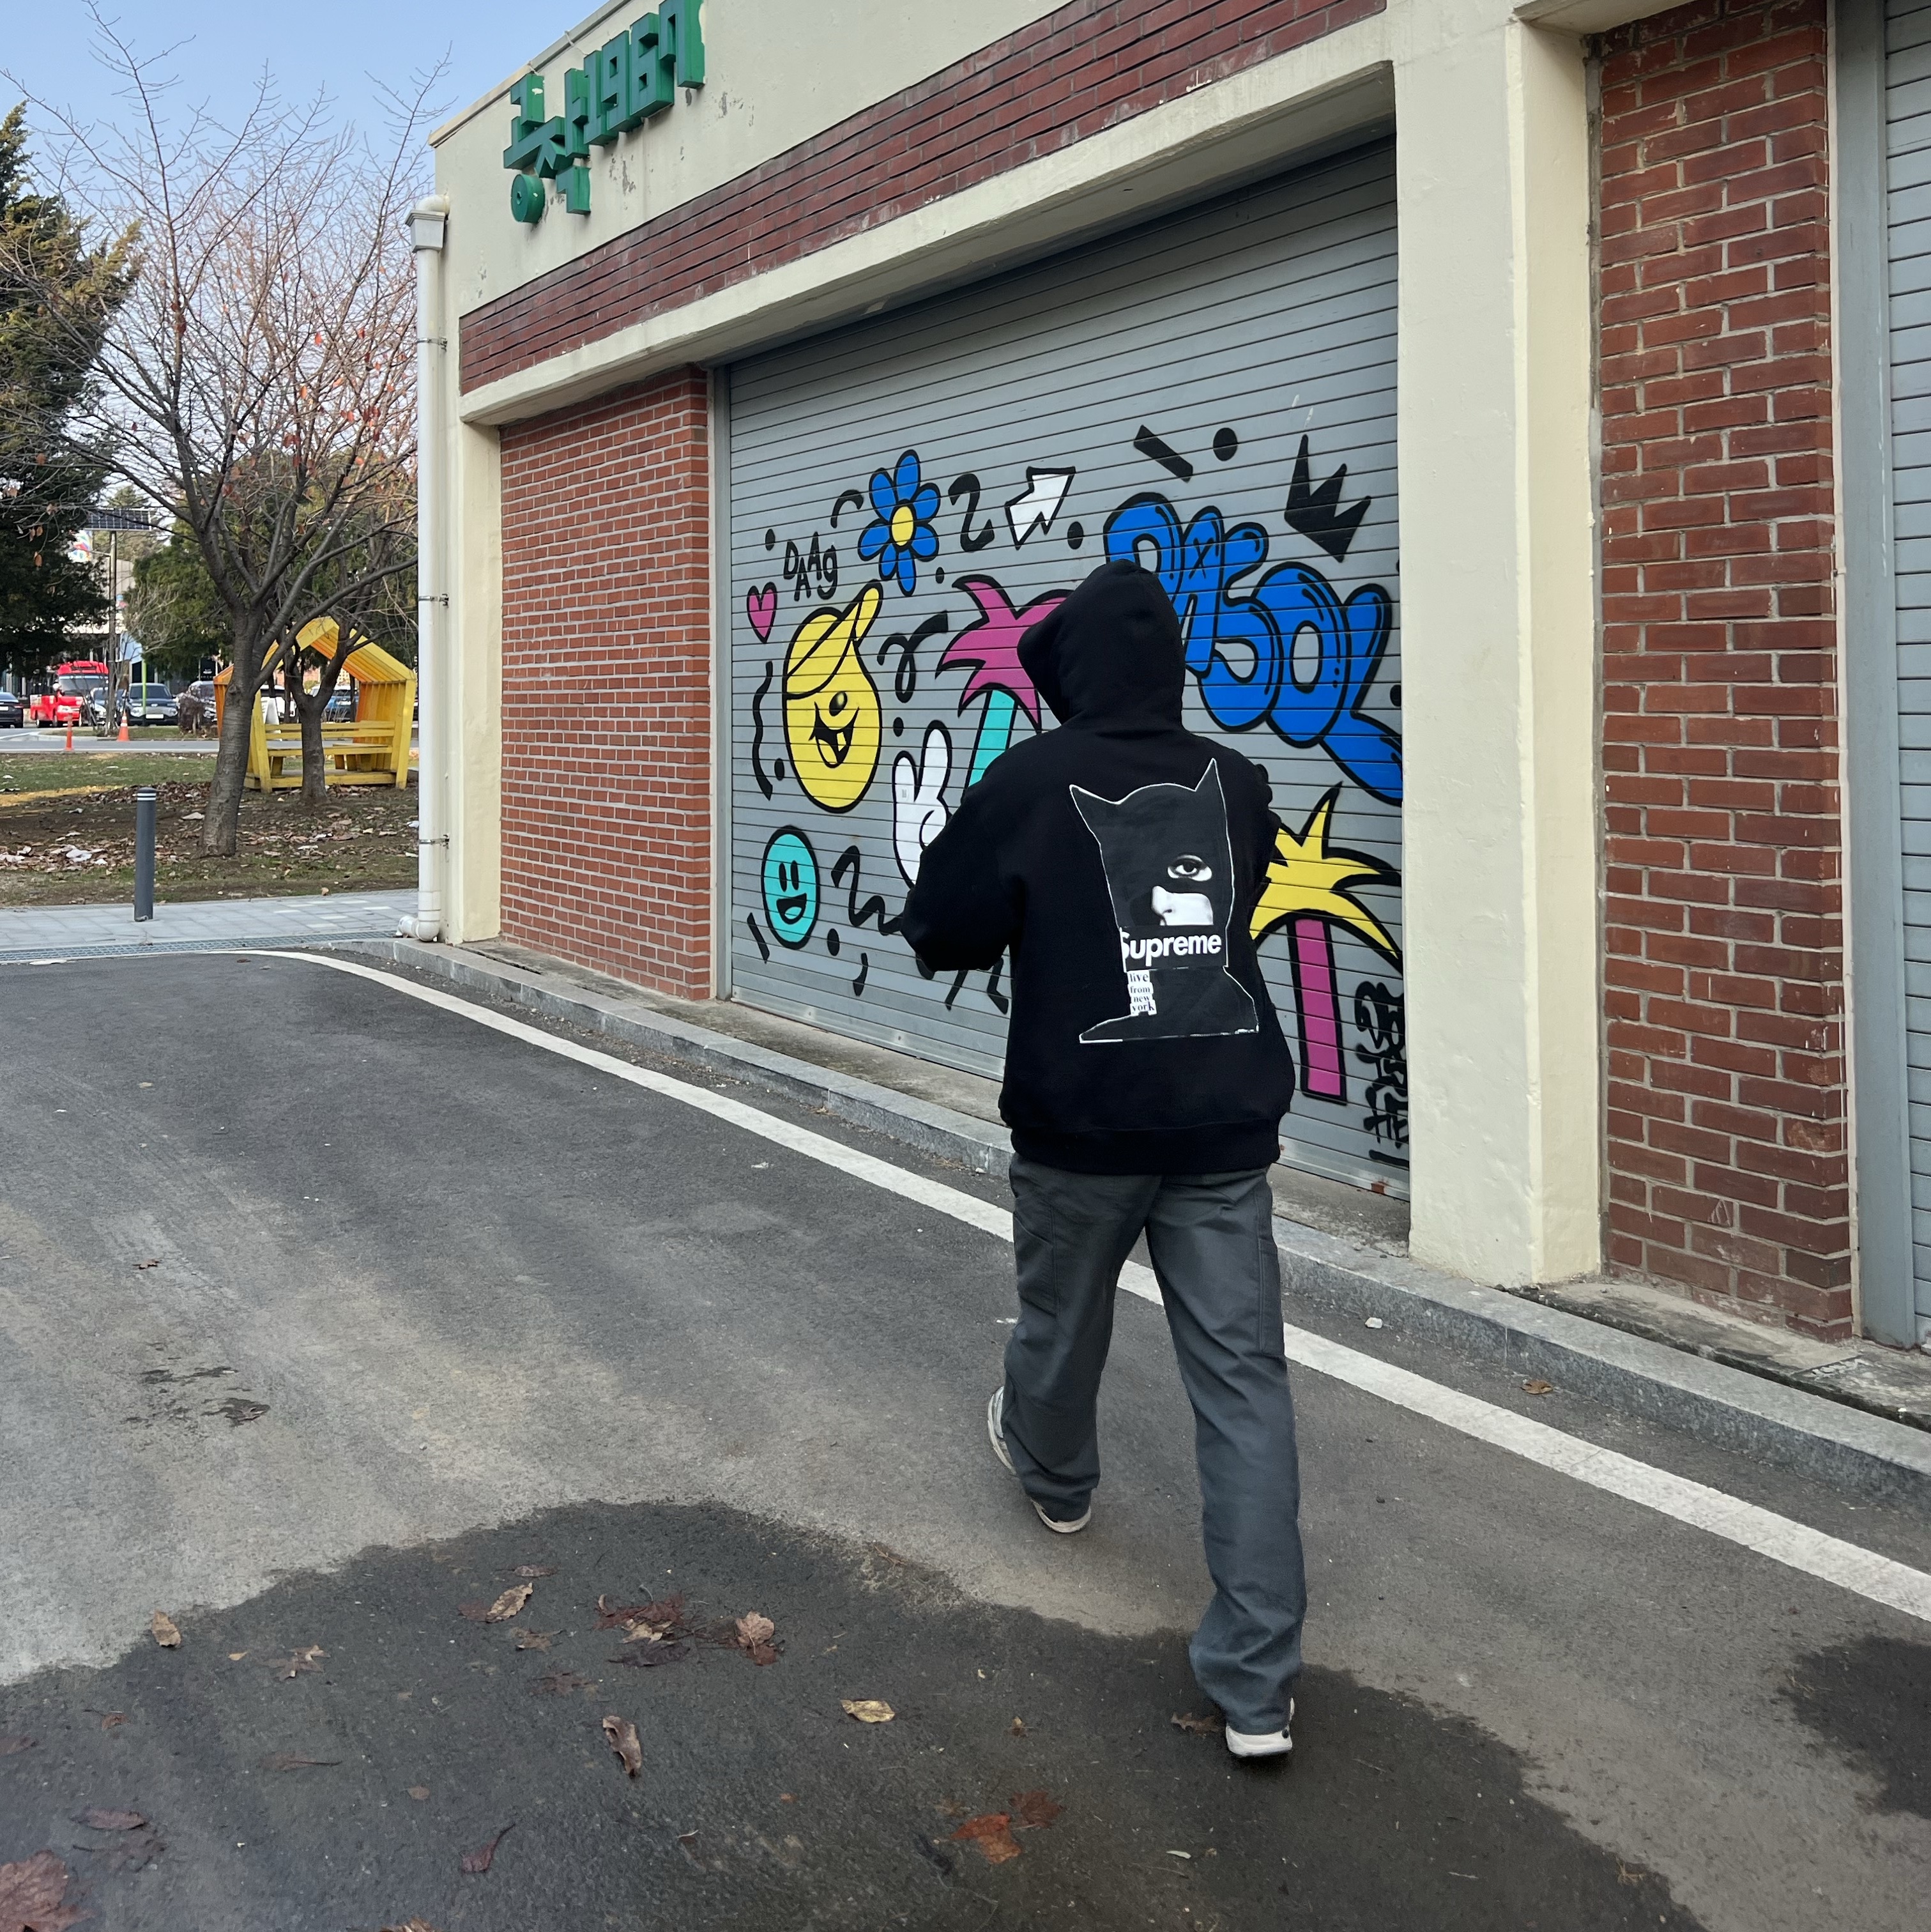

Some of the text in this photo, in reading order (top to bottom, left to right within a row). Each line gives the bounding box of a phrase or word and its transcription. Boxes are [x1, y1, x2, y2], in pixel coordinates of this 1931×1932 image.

[1129, 973, 1149, 983] live
[1130, 985, 1150, 994] from
[1131, 1001, 1155, 1014] york
